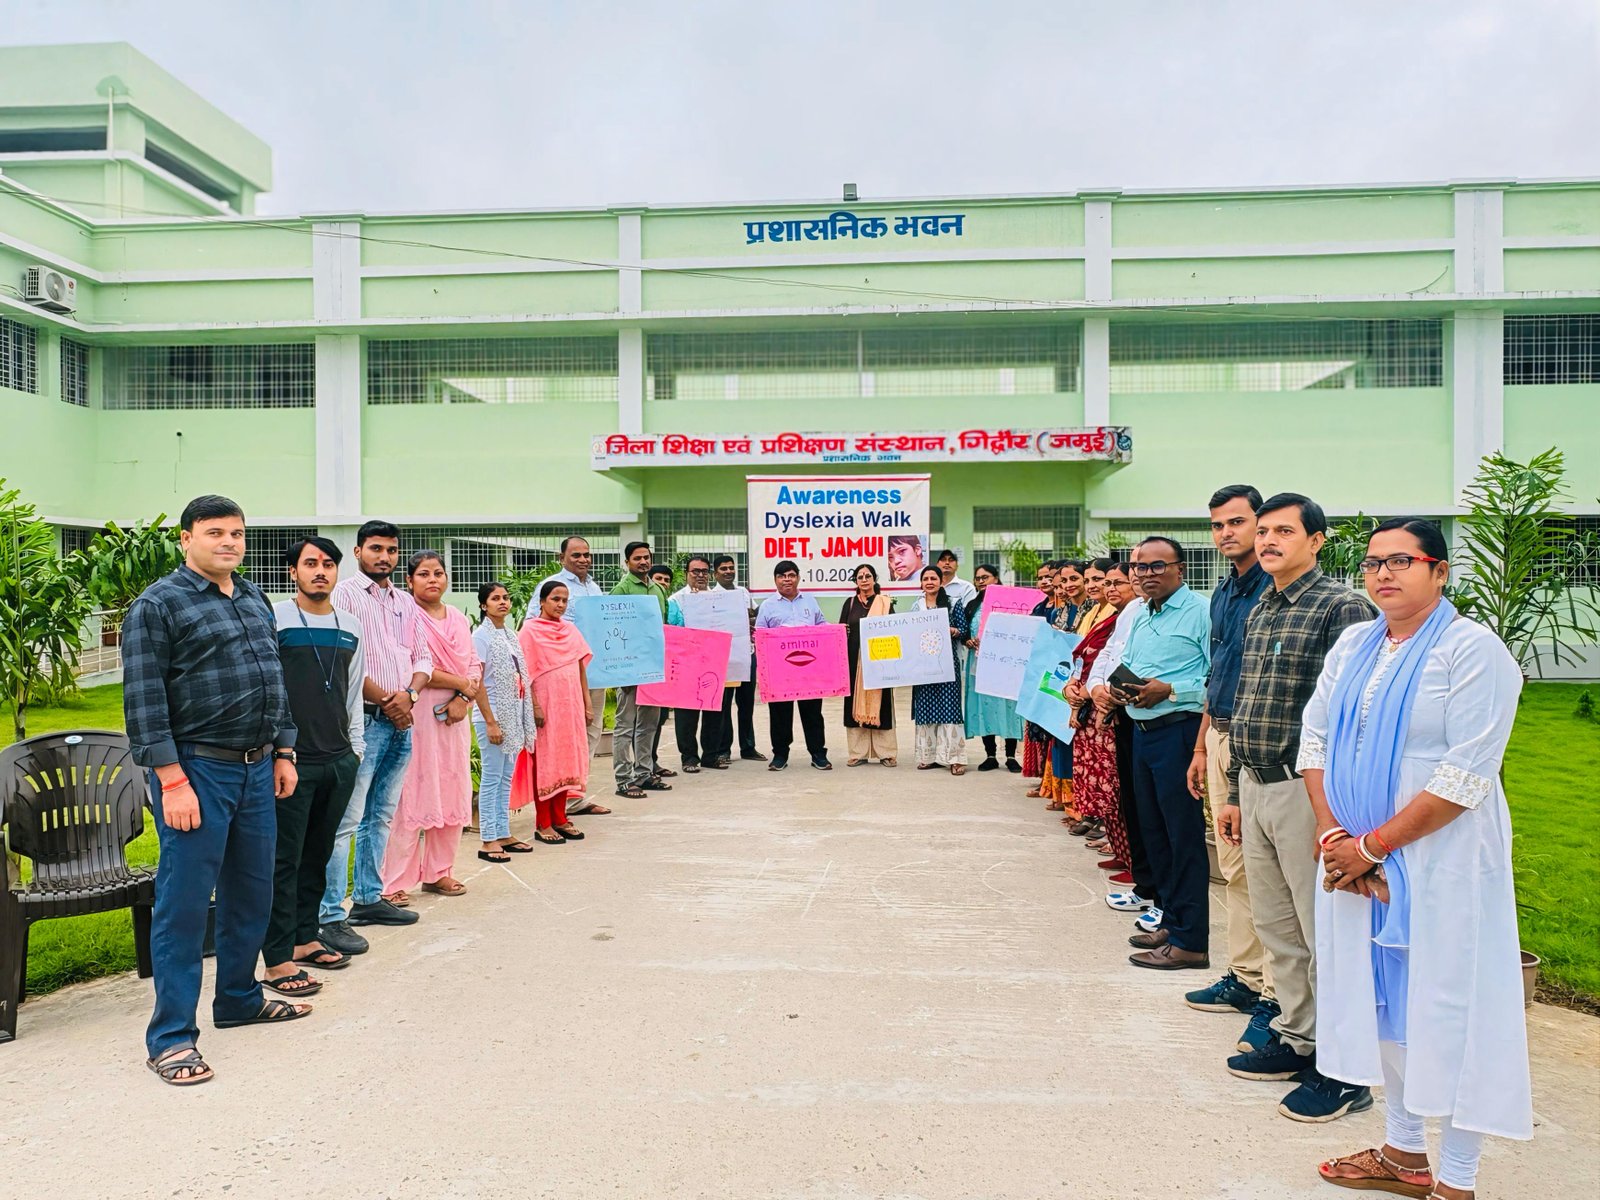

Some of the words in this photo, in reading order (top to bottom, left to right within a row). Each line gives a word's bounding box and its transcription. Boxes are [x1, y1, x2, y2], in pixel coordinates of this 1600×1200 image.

[743, 210, 888, 245] प्रशासनिक
[894, 214, 966, 238] भवन
[605, 434, 656, 454] जिला
[662, 434, 716, 457] शिक्षा
[721, 435, 752, 454] एवं
[760, 432, 847, 455] प्रशिक्षण
[776, 485, 902, 505] Awareness
[765, 511, 854, 533] Dyslexia
[862, 511, 911, 528] Walk
[764, 537, 813, 560] DIET,
[821, 536, 884, 558] JAMUI
[802, 568, 857, 582] .10.202
[601, 602, 636, 611] DYSLEXIA
[868, 618, 908, 630] DYSLEXIA
[912, 614, 940, 625] MONTH
